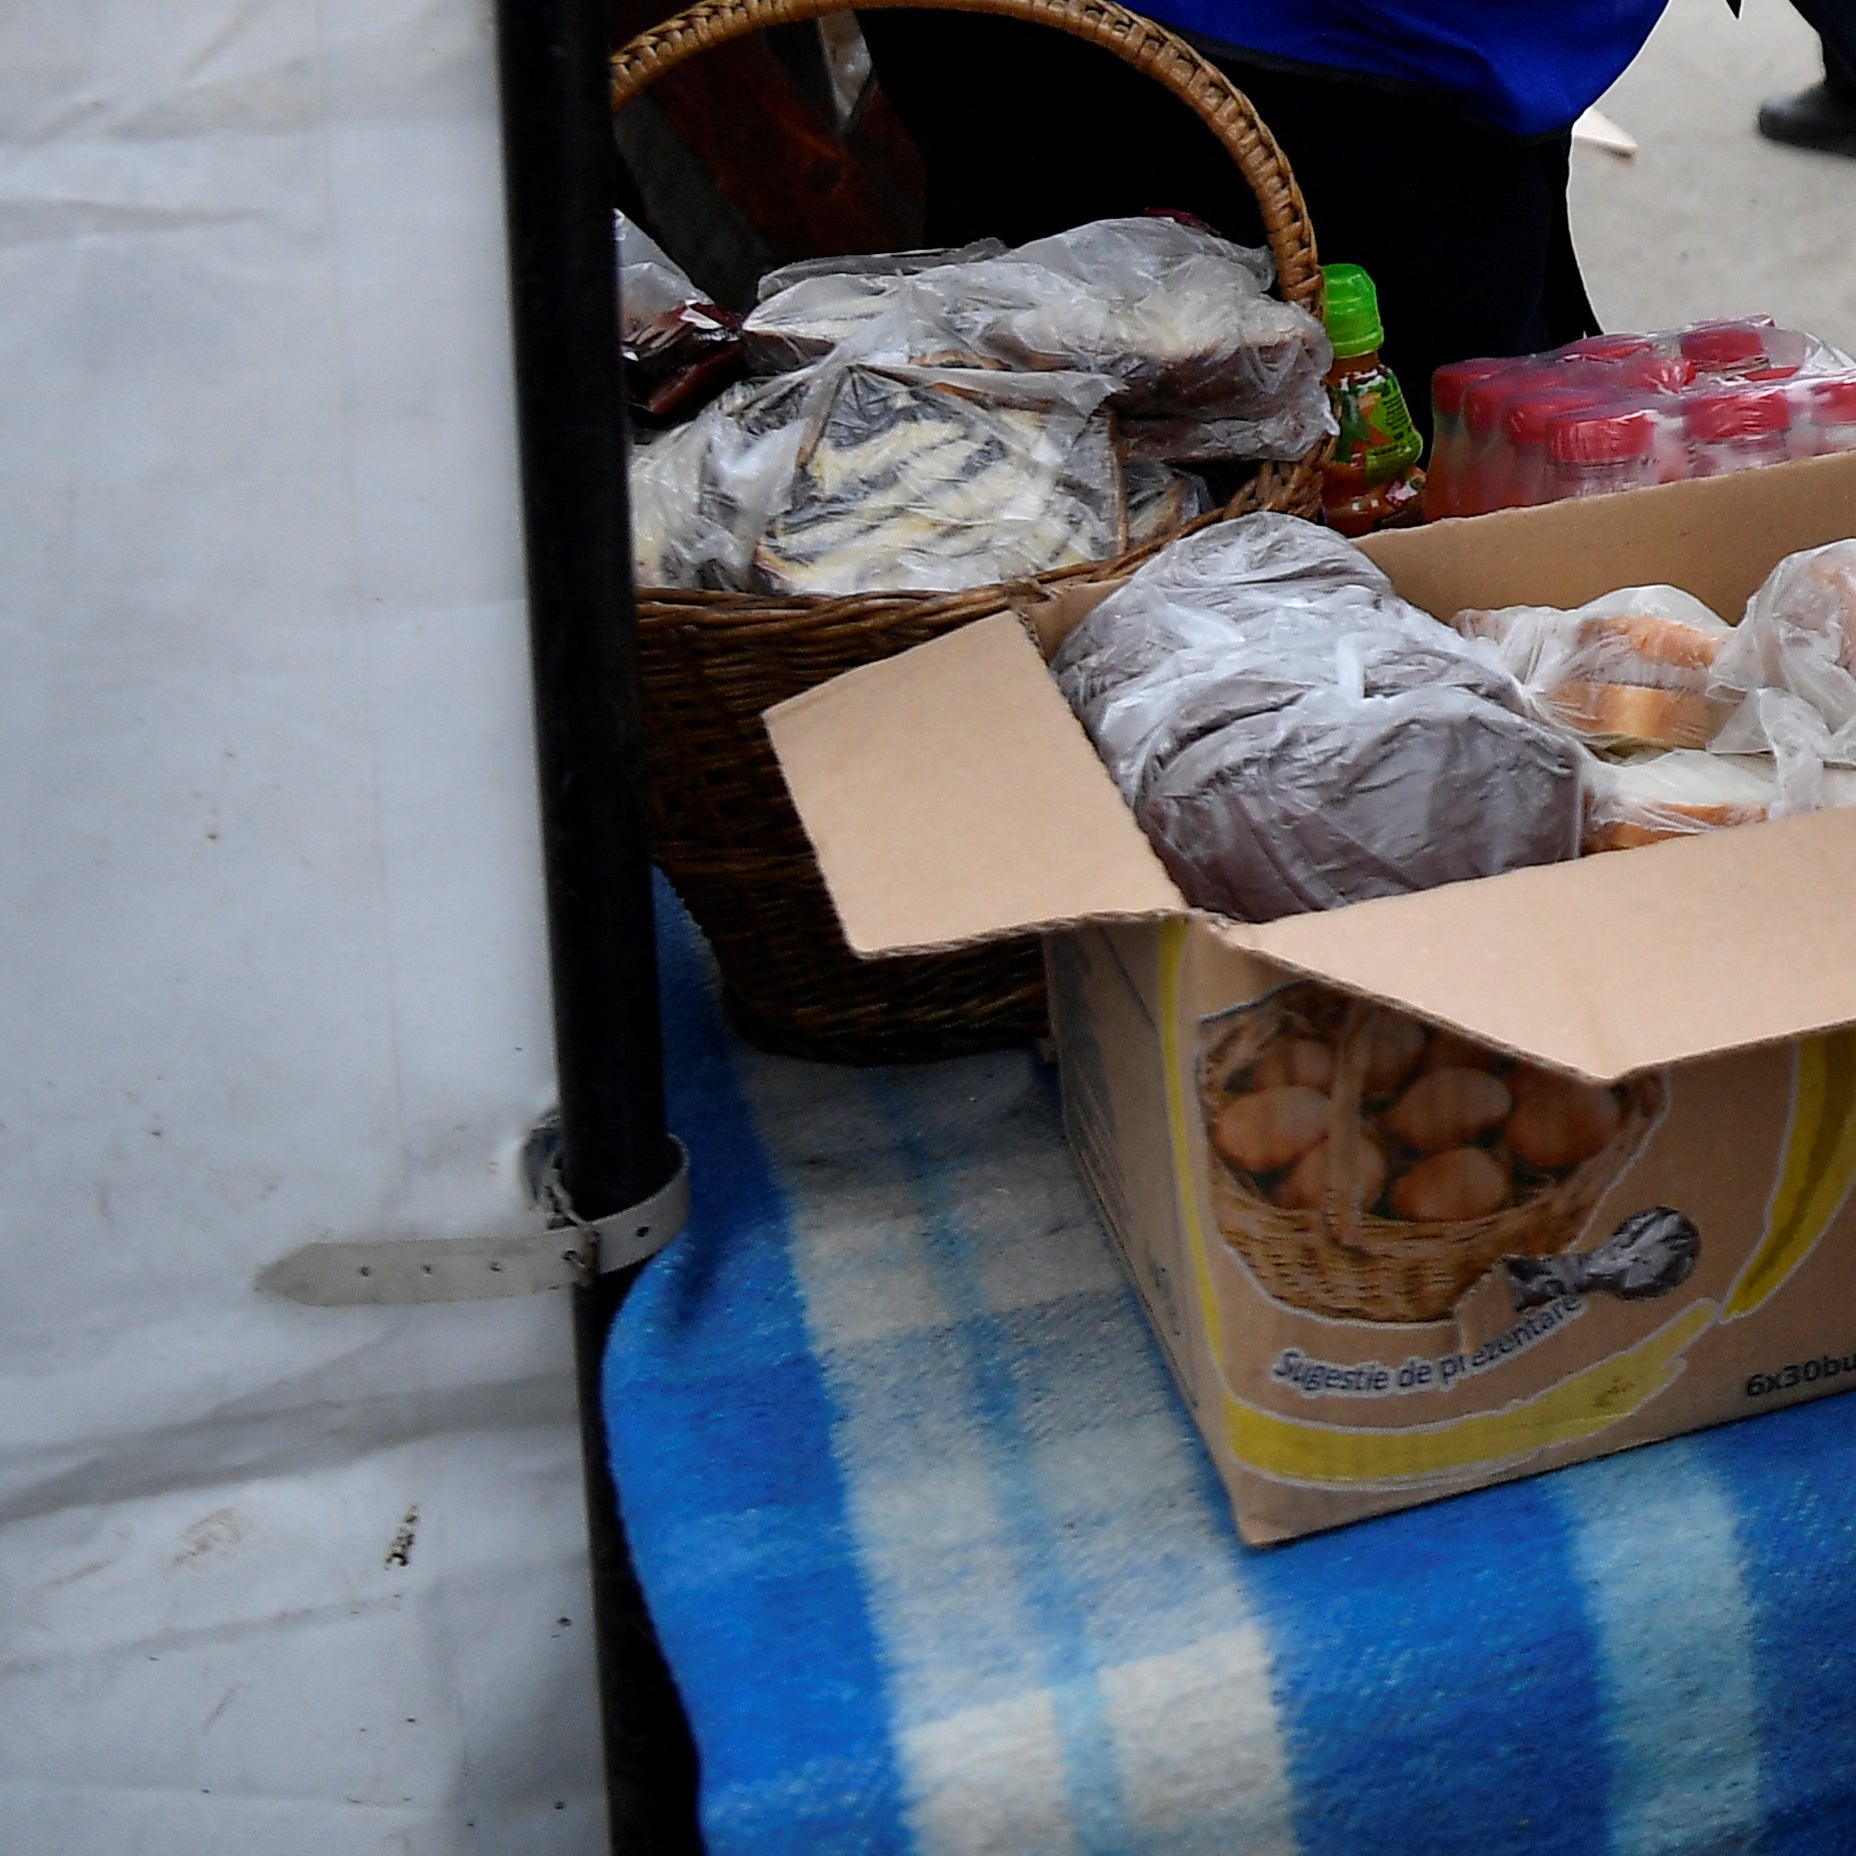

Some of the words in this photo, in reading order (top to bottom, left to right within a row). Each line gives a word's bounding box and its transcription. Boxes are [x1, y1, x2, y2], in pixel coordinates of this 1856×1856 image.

[1274, 1350, 1389, 1391] Sugestie
[1399, 1361, 1432, 1388] de
[1441, 1294, 1584, 1385] prezentare
